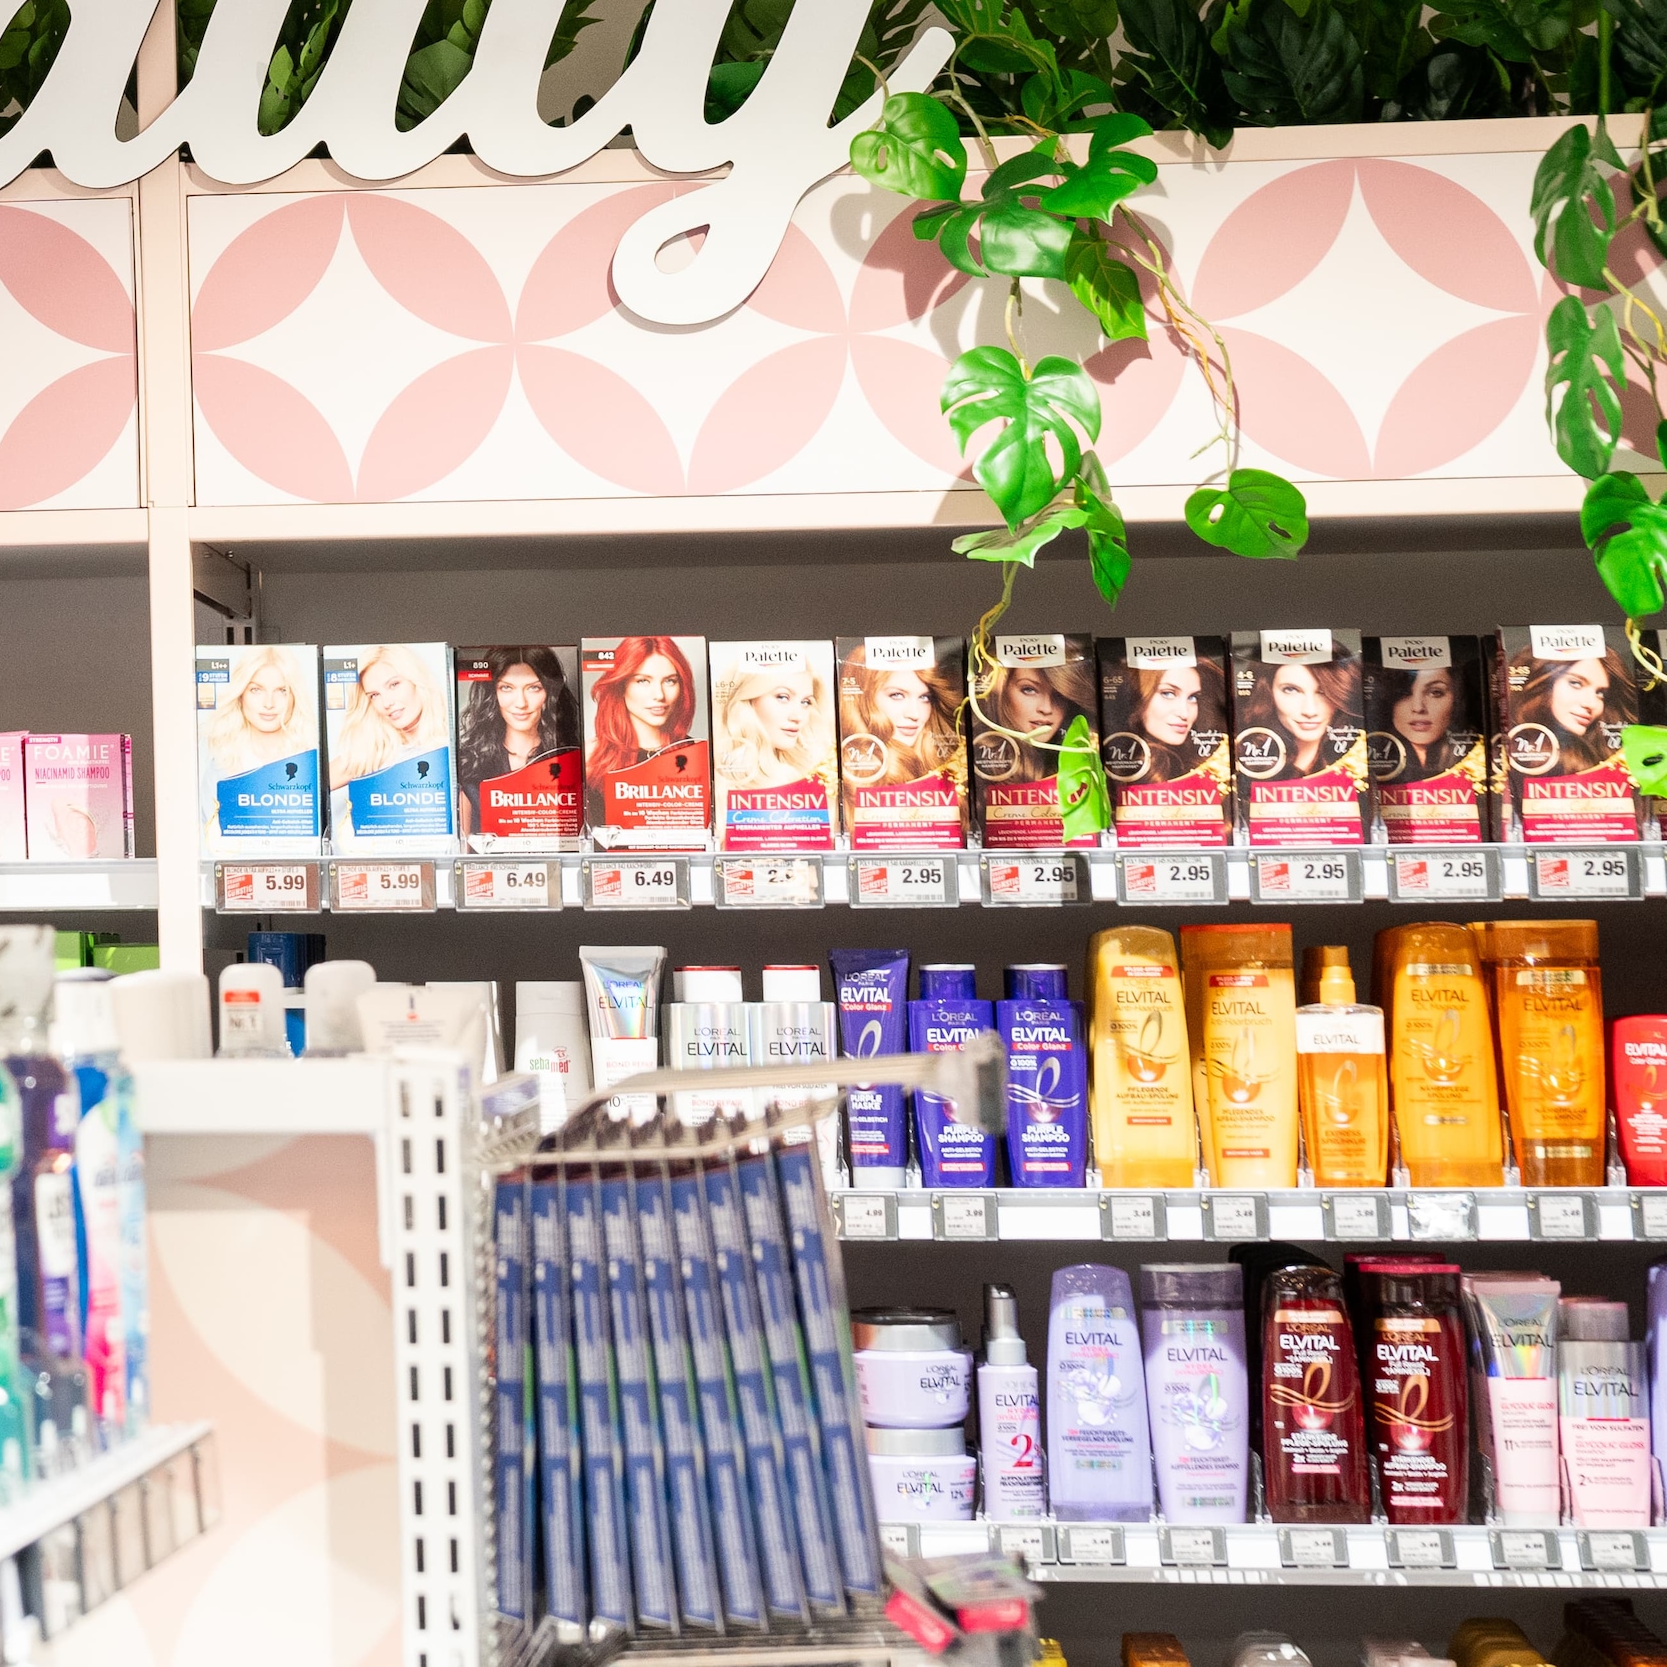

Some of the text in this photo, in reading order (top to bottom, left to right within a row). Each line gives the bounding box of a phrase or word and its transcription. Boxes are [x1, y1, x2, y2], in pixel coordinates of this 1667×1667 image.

[1268, 641, 1323, 653] Palette
[1540, 636, 1596, 648] Palette
[873, 647, 926, 658] Palette
[1004, 644, 1057, 656] Palette
[1133, 646, 1187, 658] Palette
[1388, 647, 1443, 658] Palette
[746, 652, 798, 663] Palette
[1103, 676, 1123, 684] 6-65
[34, 745, 109, 761] FOAMIE
[35, 767, 110, 780] NIACINAMID SHAMPOO
[268, 782, 312, 791] Schwarzkopf
[400, 781, 444, 790] Schwarzkopf
[616, 782, 703, 799] BRILLANCE
[1528, 783, 1627, 798] INTENSIV
[238, 793, 313, 807] BLONDE
[370, 792, 445, 806] BLONDE
[490, 791, 576, 807] BRILLANCE
[731, 794, 824, 809] INTENSIV
[860, 791, 954, 806] INTENSIV
[1122, 790, 1215, 805] INTENSIV
[1255, 787, 1353, 802] INTENSIV
[1378, 789, 1471, 804] INTENSIV
[1034, 867, 1074, 882] 2.95
[1170, 866, 1209, 881] 2.95
[1304, 864, 1344, 879] 2.95
[1443, 862, 1483, 877] 2.95
[1584, 861, 1624, 875] 2.95
[266, 875, 304, 890] 5.99
[381, 874, 419, 889] 5.99
[507, 873, 546, 887] 6.49
[635, 871, 674, 886] 6.49
[902, 869, 941, 883] 2.95
[599, 996, 653, 1008] ELVITAL
[841, 988, 892, 1002] ELVITAL
[1116, 991, 1171, 1004] ELVITAL
[1411, 990, 1469, 1002] ELVITAL
[1212, 1002, 1265, 1016] ELVITAL
[1524, 998, 1583, 1012] ELVITAL
[1012, 1027, 1071, 1042] ELVITAL
[1314, 1034, 1361, 1045] ELVITAL
[687, 1042, 747, 1056] ELVITAL
[769, 1042, 826, 1056] ELVITAL
[529, 1059, 569, 1073] sebamed
[851, 1095, 882, 1103] PURPLE
[944, 1126, 978, 1134] PURPLE
[938, 1134, 984, 1143] SHAMPOO
[1021, 1134, 1070, 1142] SHAMPOO
[1065, 1333, 1123, 1346] ELVITAL
[1280, 1335, 1340, 1350] ELVITAL
[1492, 1334, 1554, 1347] ELVITAL
[1167, 1348, 1228, 1361] ELVITAL
[1377, 1345, 1439, 1361] ELVITAL
[920, 1376, 961, 1389] ELVITAL
[1574, 1383, 1639, 1397] ELVITAL
[995, 1395, 1039, 1407] ELVITAL
[897, 1482, 945, 1493] ELVITAL
